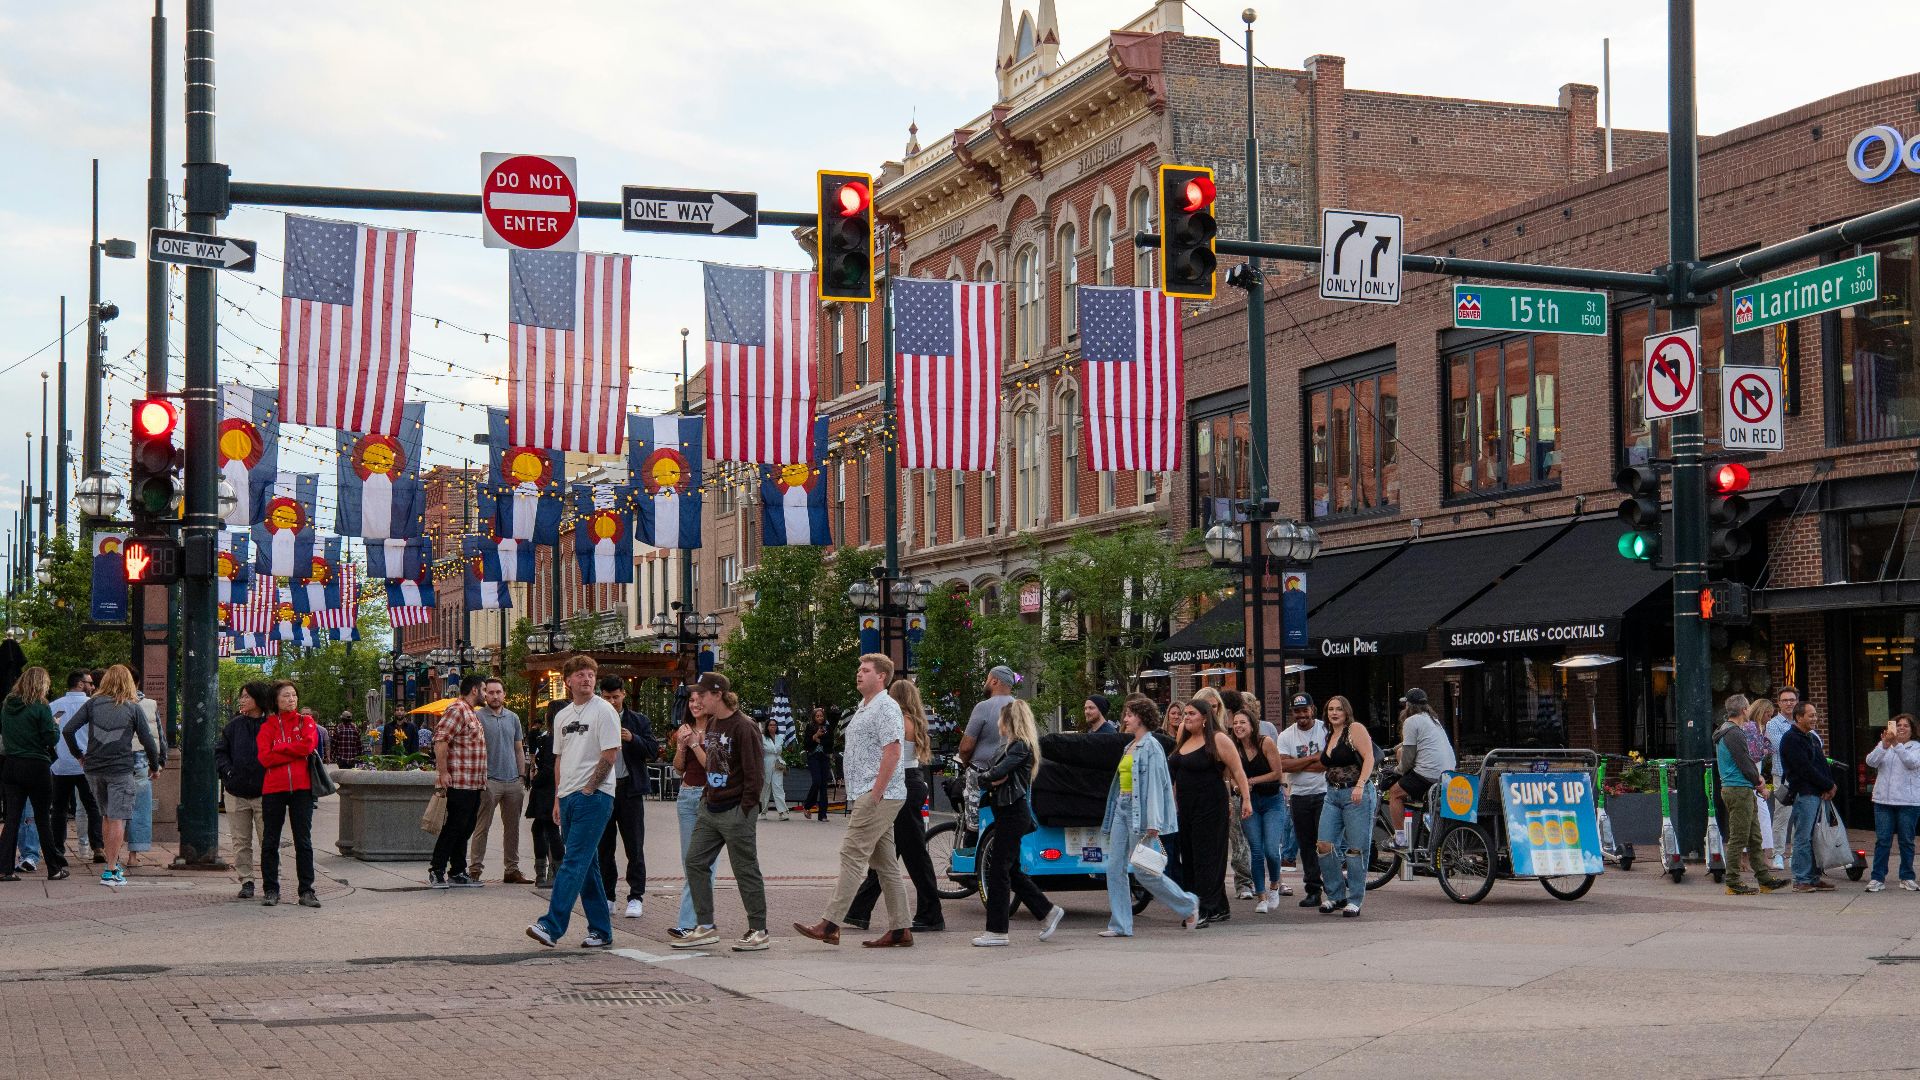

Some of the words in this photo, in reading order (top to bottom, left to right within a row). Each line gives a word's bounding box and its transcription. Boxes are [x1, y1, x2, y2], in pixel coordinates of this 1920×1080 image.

[1077, 135, 1123, 174] STANBURY
[496, 172, 519, 188] DO
[529, 174, 563, 190] NOT
[634, 201, 668, 219] ONE
[677, 203, 713, 222] WAY
[503, 215, 558, 232] ENTER
[161, 239, 190, 255] ONE
[195, 243, 225, 259] WAY
[1326, 278, 1357, 294] ONLY
[1364, 280, 1395, 296] ONLY
[1760, 275, 1844, 319] Larimer
[1856, 265, 1866, 279] St
[1850, 278, 1873, 295] 1300
[1458, 310, 1481, 320] DENVER
[1510, 295, 1559, 324] 15th
[1586, 300, 1596, 313] St
[1581, 314, 1601, 327] 1500
[1729, 427, 1746, 443] ON
[1752, 428, 1776, 444] RED
[1451, 631, 1495, 646] SEAFOOD
[1502, 628, 1539, 643] STEAKS
[1547, 624, 1605, 640] COCKTAILS
[1163, 650, 1192, 663] SEAFOOD
[1196, 648, 1220, 661] STEAKS
[1510, 782, 1559, 805] SUN'S
[1562, 781, 1585, 804] UP
